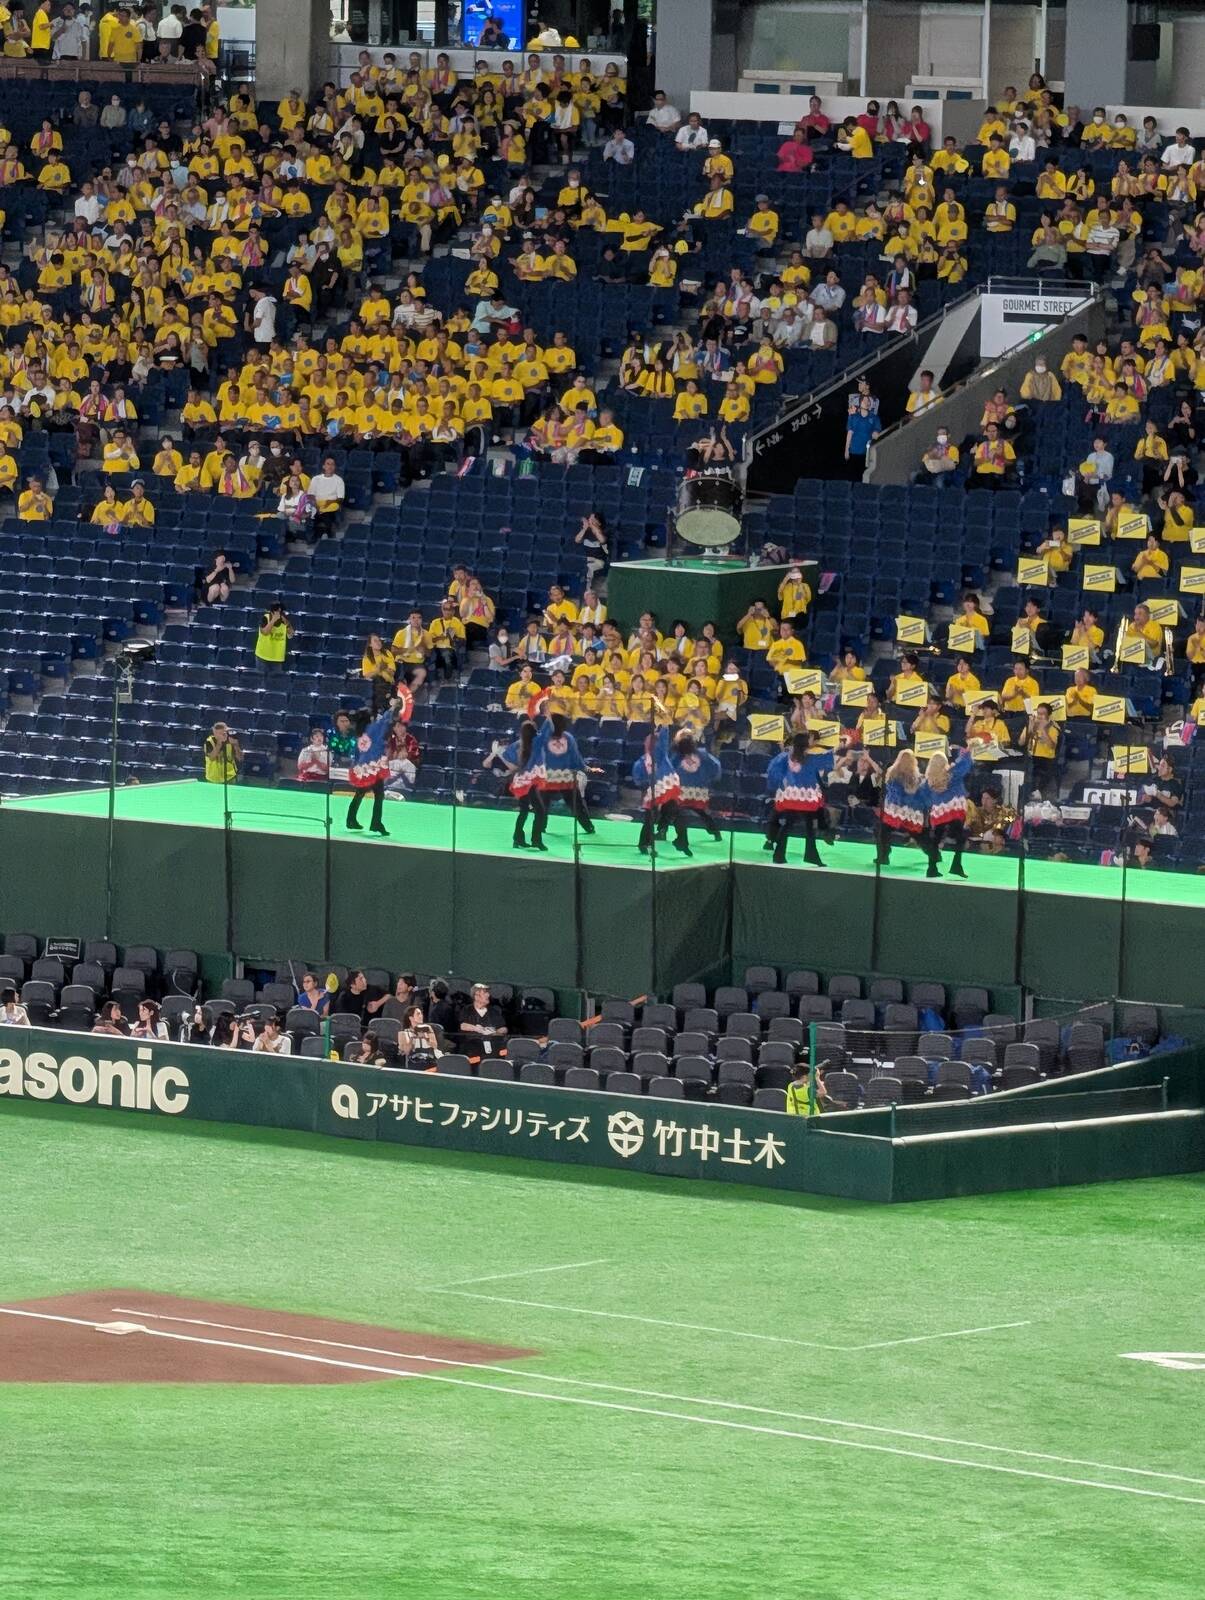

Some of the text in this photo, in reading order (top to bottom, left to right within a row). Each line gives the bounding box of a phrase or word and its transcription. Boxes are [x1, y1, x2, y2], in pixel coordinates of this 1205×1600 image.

[1003, 299, 1073, 312] GOURMET STREET
[366, 1091, 591, 1144] アサヒファシリティズ
[652, 1119, 787, 1170] 竹中土木
